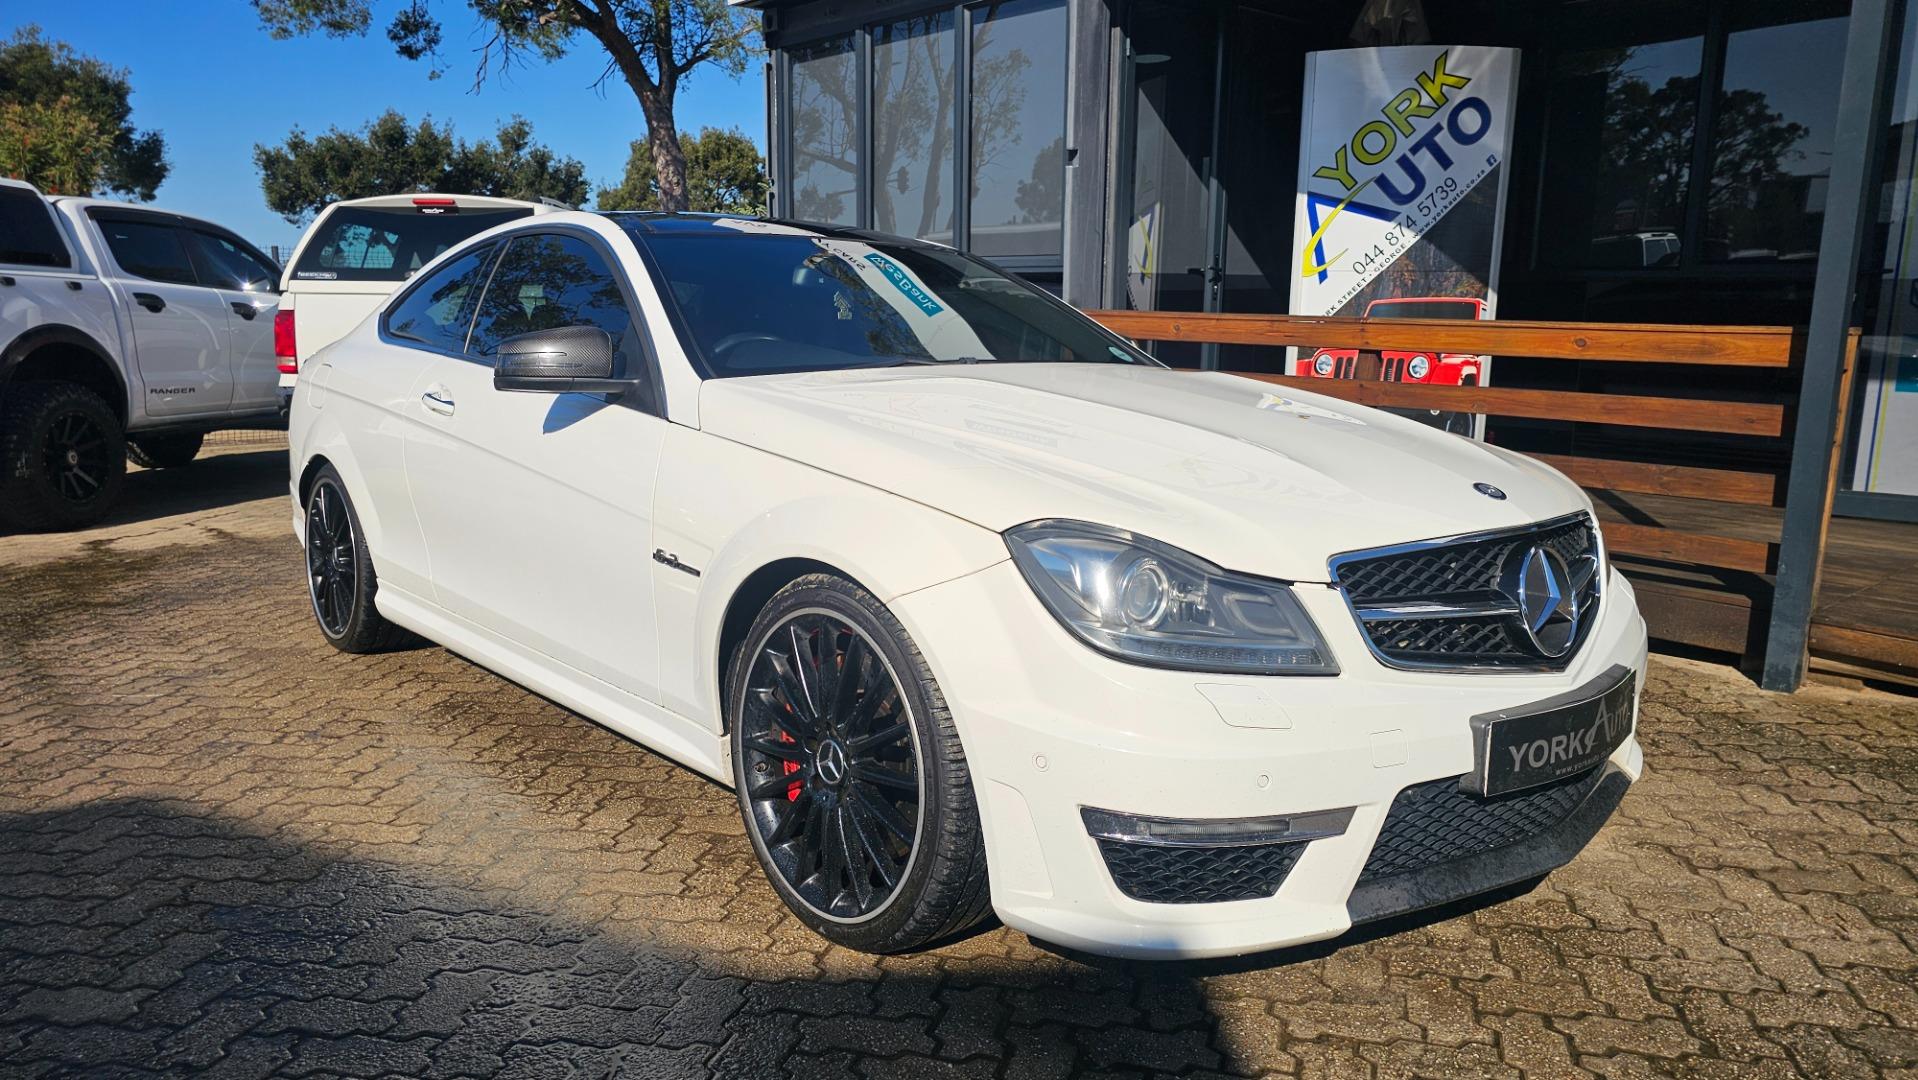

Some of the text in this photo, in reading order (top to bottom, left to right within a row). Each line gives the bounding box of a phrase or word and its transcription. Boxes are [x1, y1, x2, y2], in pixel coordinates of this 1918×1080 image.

[1312, 49, 1472, 191] YORK
[1302, 96, 1492, 284] AUTO
[1337, 276, 1368, 305] STREET
[1373, 242, 1406, 273] GEORGE
[1412, 169, 1485, 239] www.yorkauto.co.za
[1352, 177, 1457, 275] 044 874 5739
[1508, 728, 1586, 772] YORK
